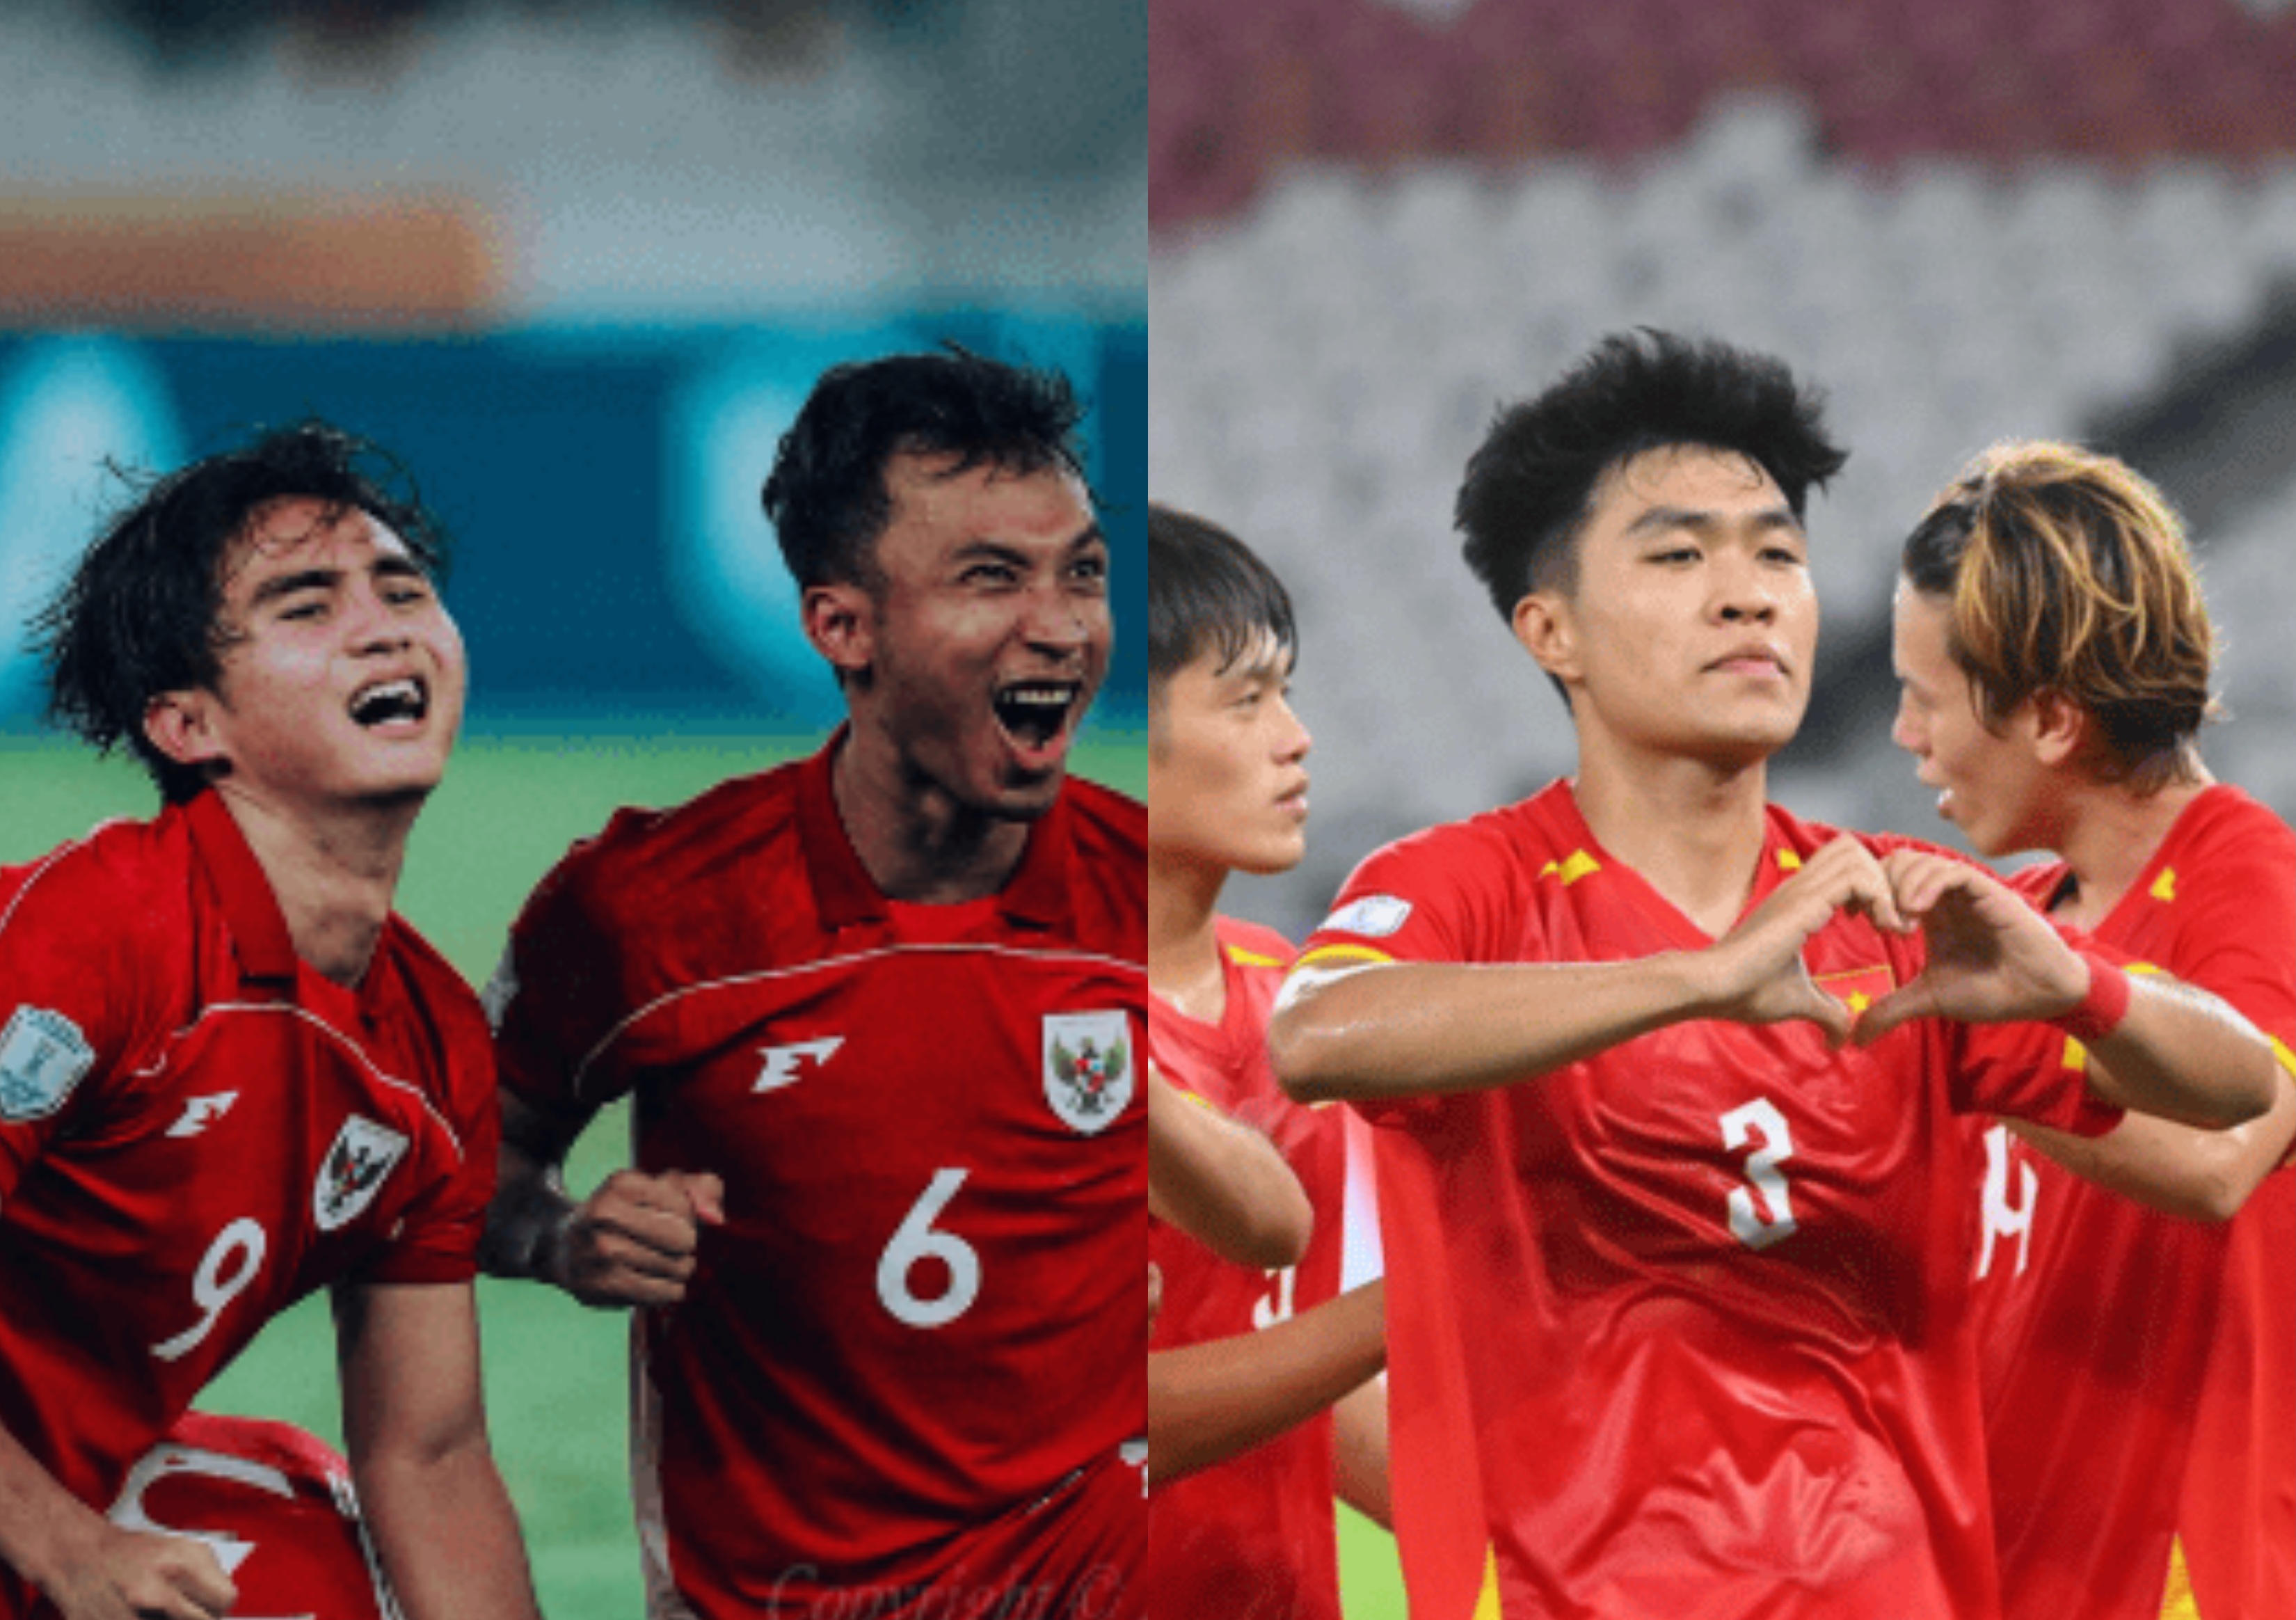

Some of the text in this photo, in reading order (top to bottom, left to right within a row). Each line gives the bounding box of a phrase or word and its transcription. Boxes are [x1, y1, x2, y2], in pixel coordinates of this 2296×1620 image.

[876, 1167, 982, 1328] 6
[1716, 1096, 1798, 1252] 3
[151, 1217, 267, 1363] 9
